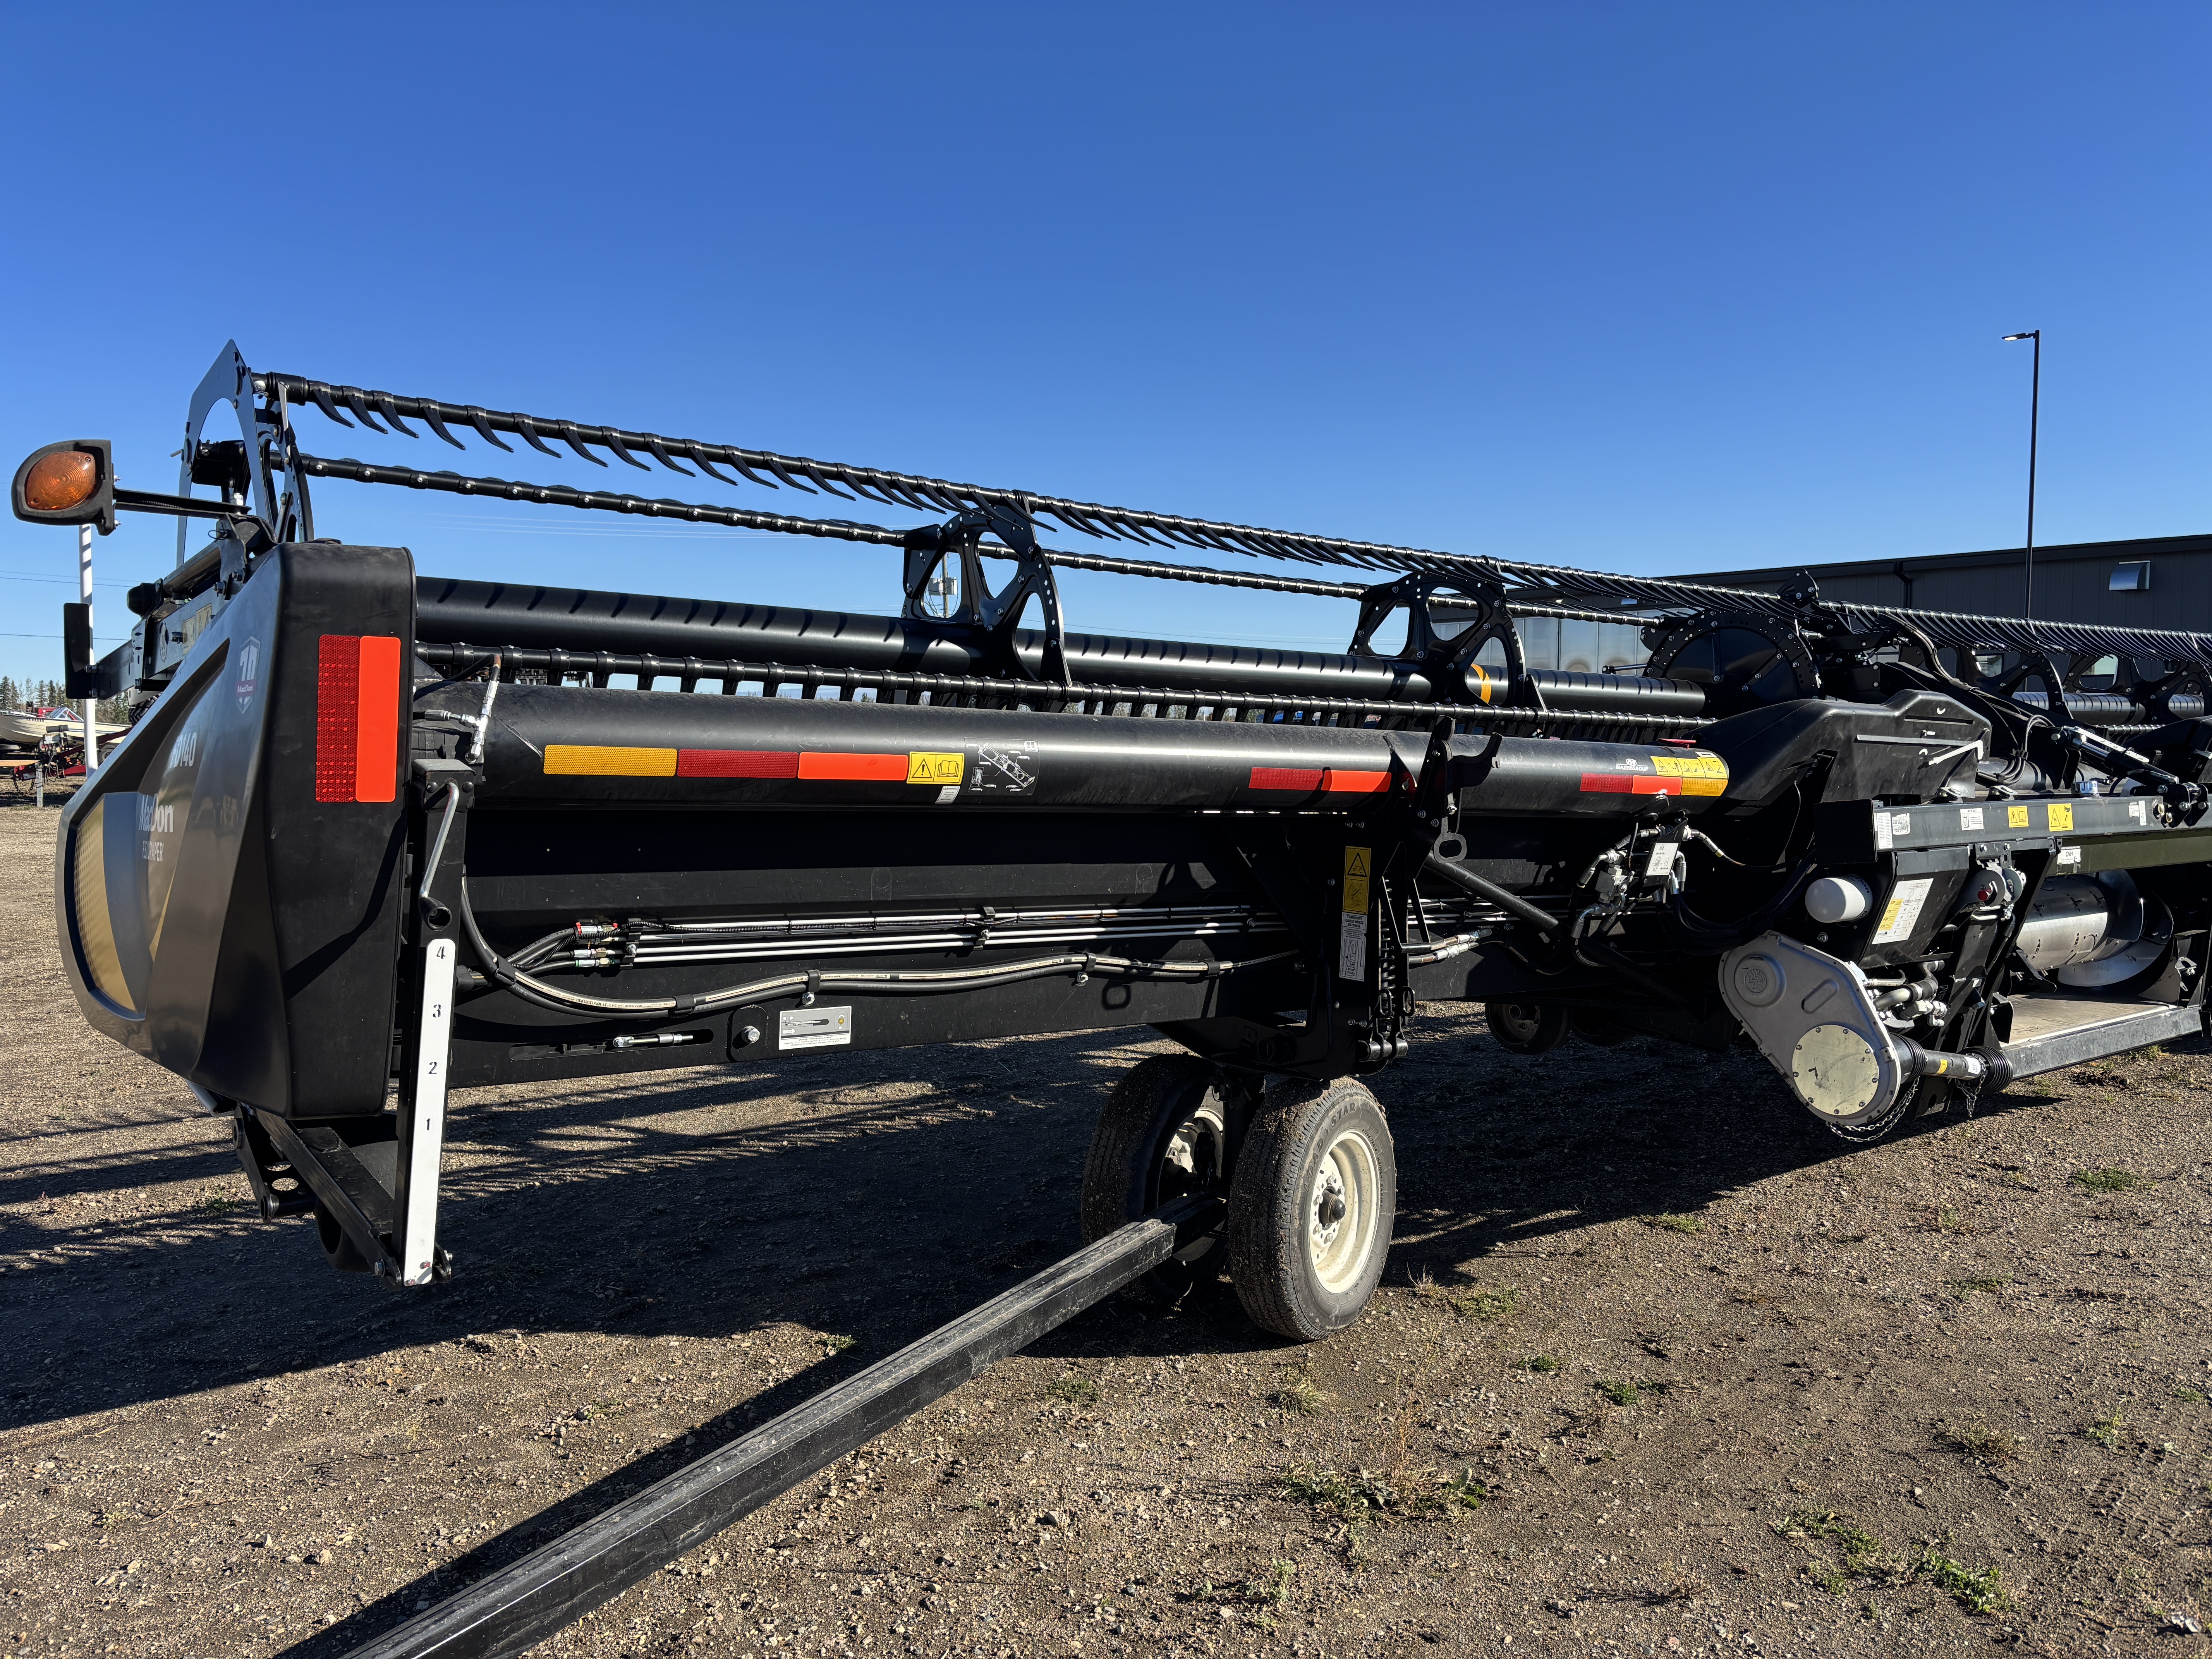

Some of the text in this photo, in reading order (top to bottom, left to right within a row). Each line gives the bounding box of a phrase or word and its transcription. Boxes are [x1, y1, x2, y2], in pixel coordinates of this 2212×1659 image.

[237, 684, 253, 693] MacDon
[139, 793, 173, 833] MacDon
[436, 946, 446, 959] 4
[432, 1004, 441, 1018] 3
[428, 1061, 437, 1075] 2
[426, 1118, 431, 1131] 1
[1304, 1103, 1356, 1192] LOAD STAR
